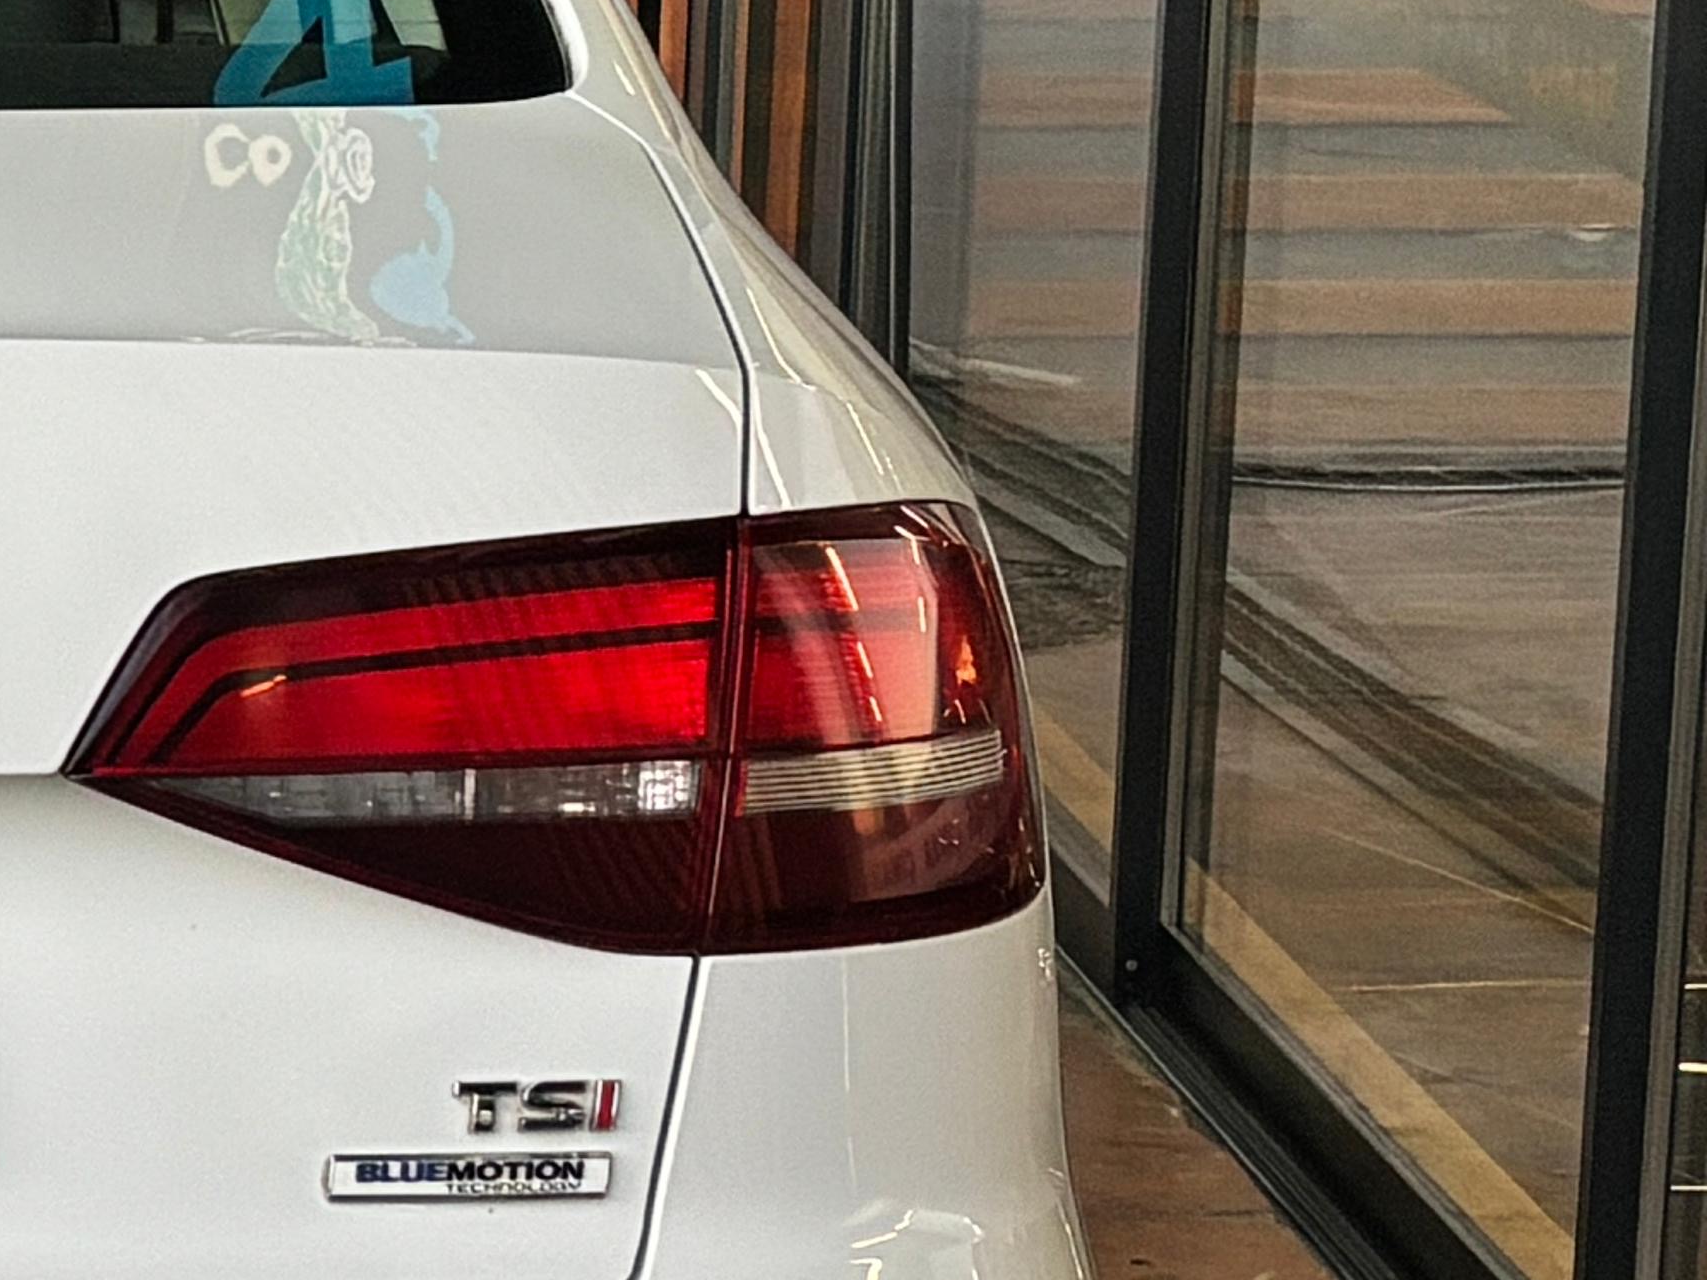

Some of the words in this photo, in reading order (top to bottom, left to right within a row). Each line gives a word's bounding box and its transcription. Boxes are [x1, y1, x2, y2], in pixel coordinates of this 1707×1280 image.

[452, 1078, 624, 1135] TSI
[354, 1159, 585, 1183] BLUEMOTION
[445, 1182, 583, 1195] TECHNOLOGY
